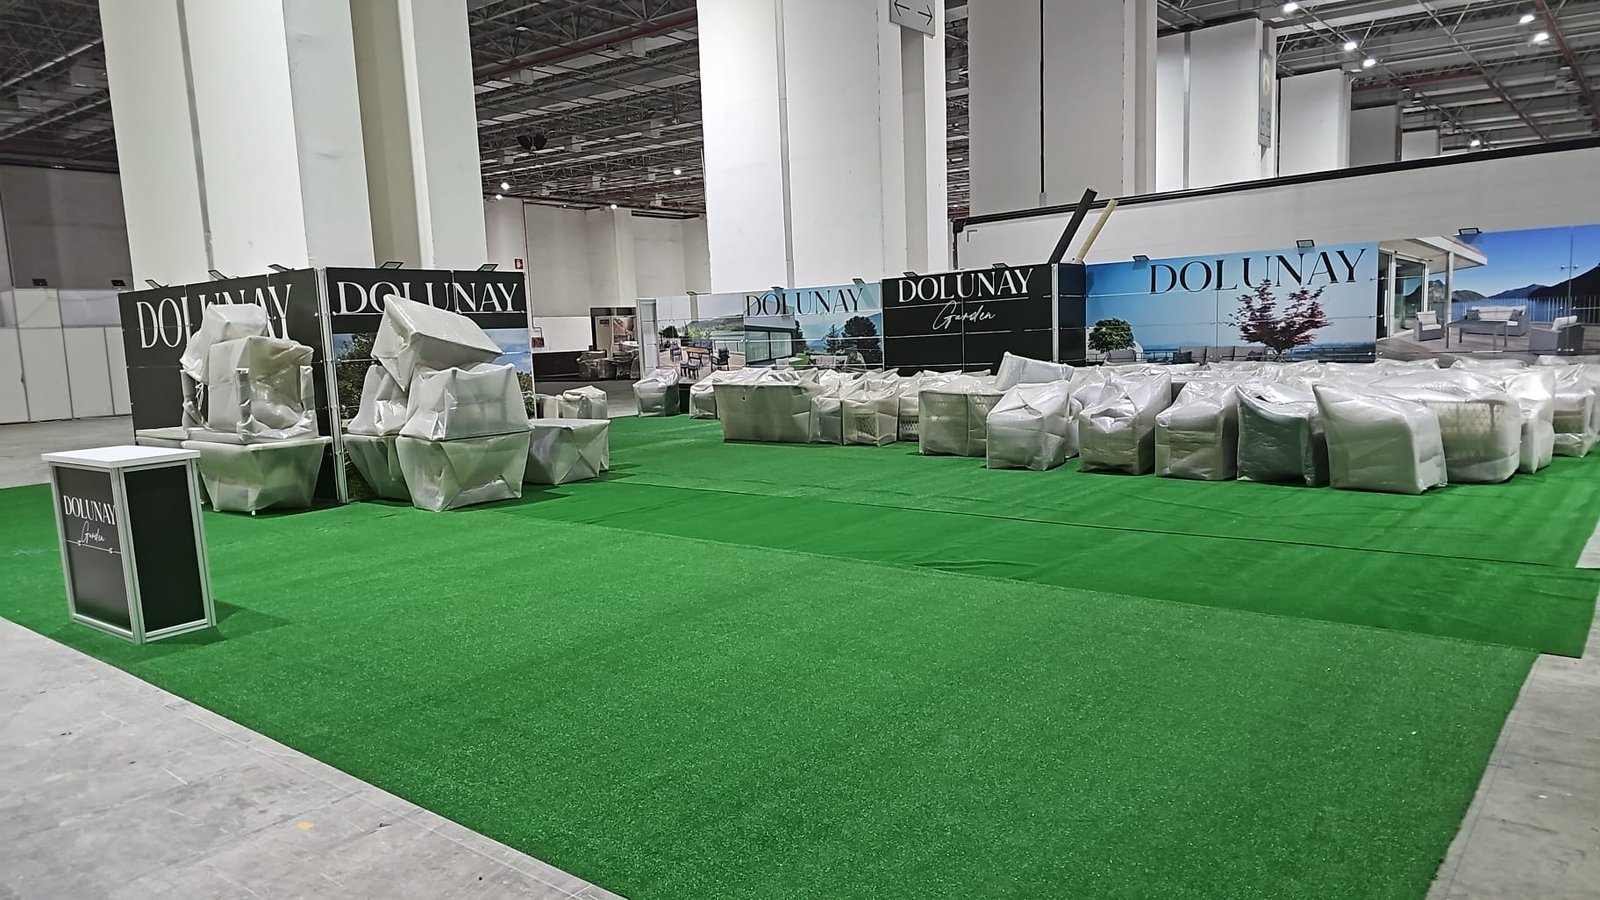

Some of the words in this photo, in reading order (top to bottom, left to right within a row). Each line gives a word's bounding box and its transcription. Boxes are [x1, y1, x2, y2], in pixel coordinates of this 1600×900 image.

[898, 267, 1034, 303] DOLUNAY
[1150, 248, 1367, 295] DOLUNAY
[745, 287, 864, 317] DOLUNAY
[932, 300, 996, 330] Garden
[63, 495, 116, 525] DOLUNAY
